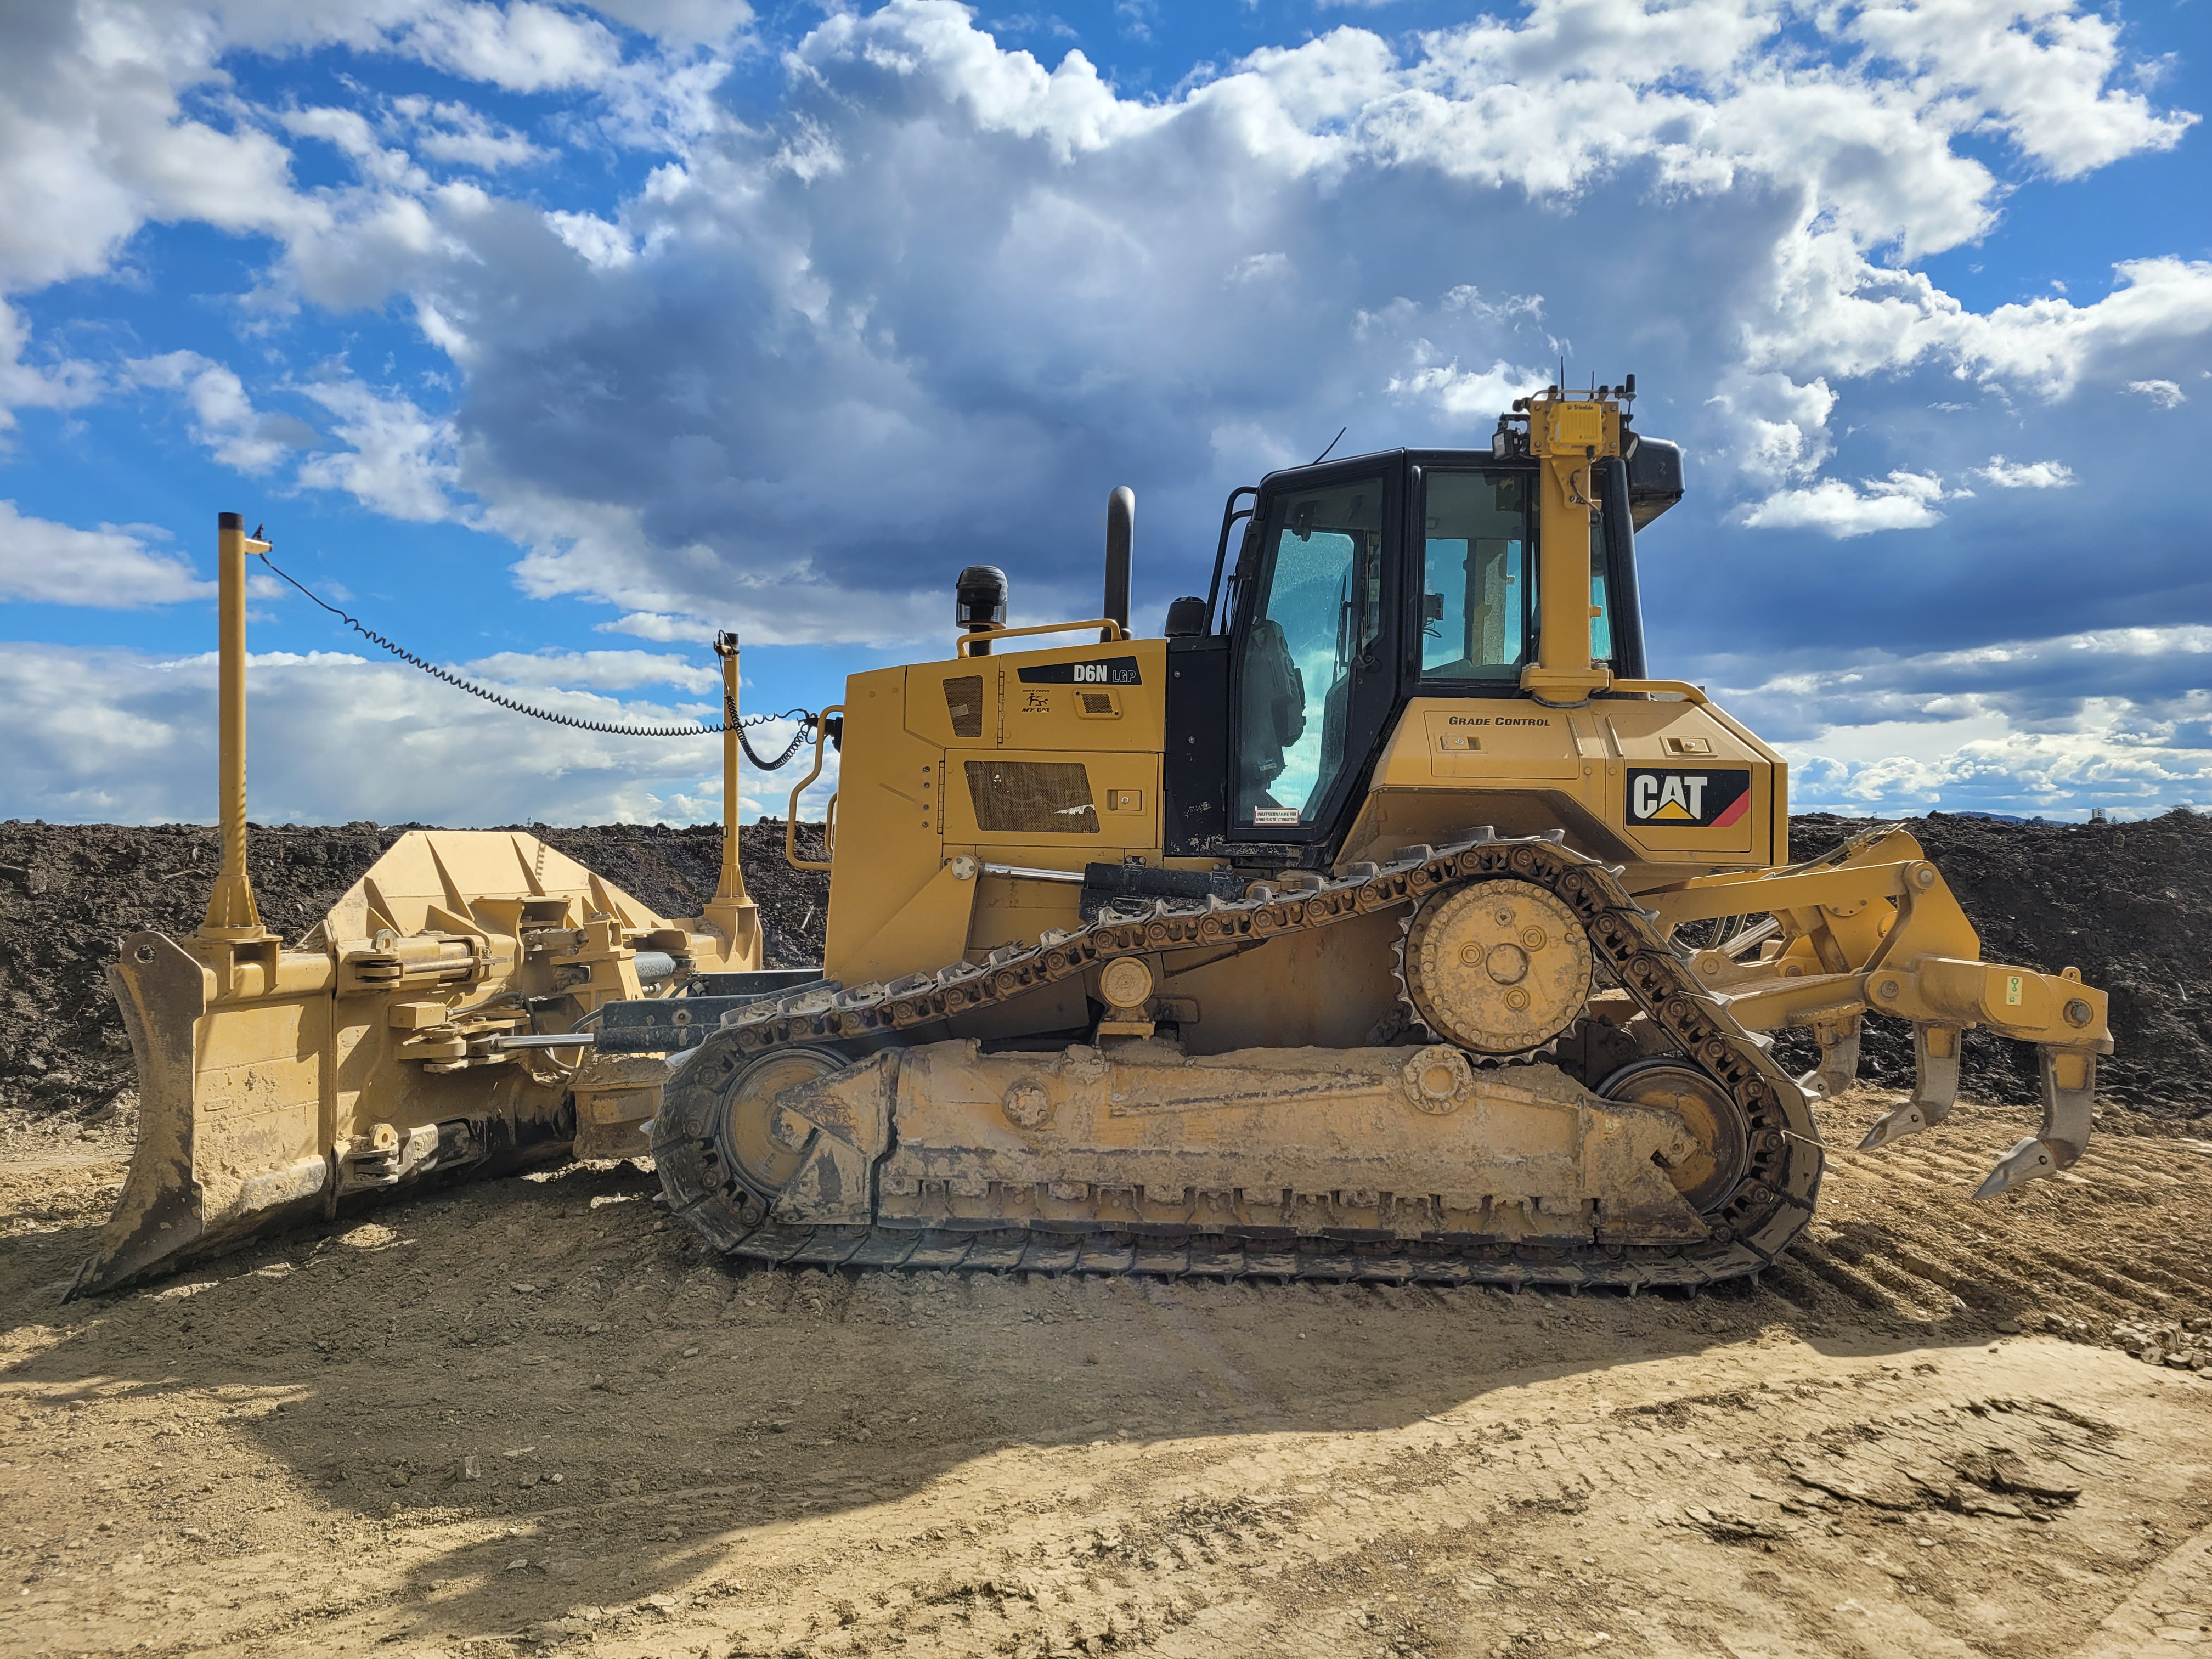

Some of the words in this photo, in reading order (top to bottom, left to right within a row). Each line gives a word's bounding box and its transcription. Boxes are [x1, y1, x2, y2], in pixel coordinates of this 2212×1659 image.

[1074, 664, 1107, 682] D6N
[1112, 669, 1136, 682] LGP
[1448, 716, 1491, 726] GRADE
[1494, 717, 1551, 726] CONTROL
[1634, 775, 1708, 820] CAT
